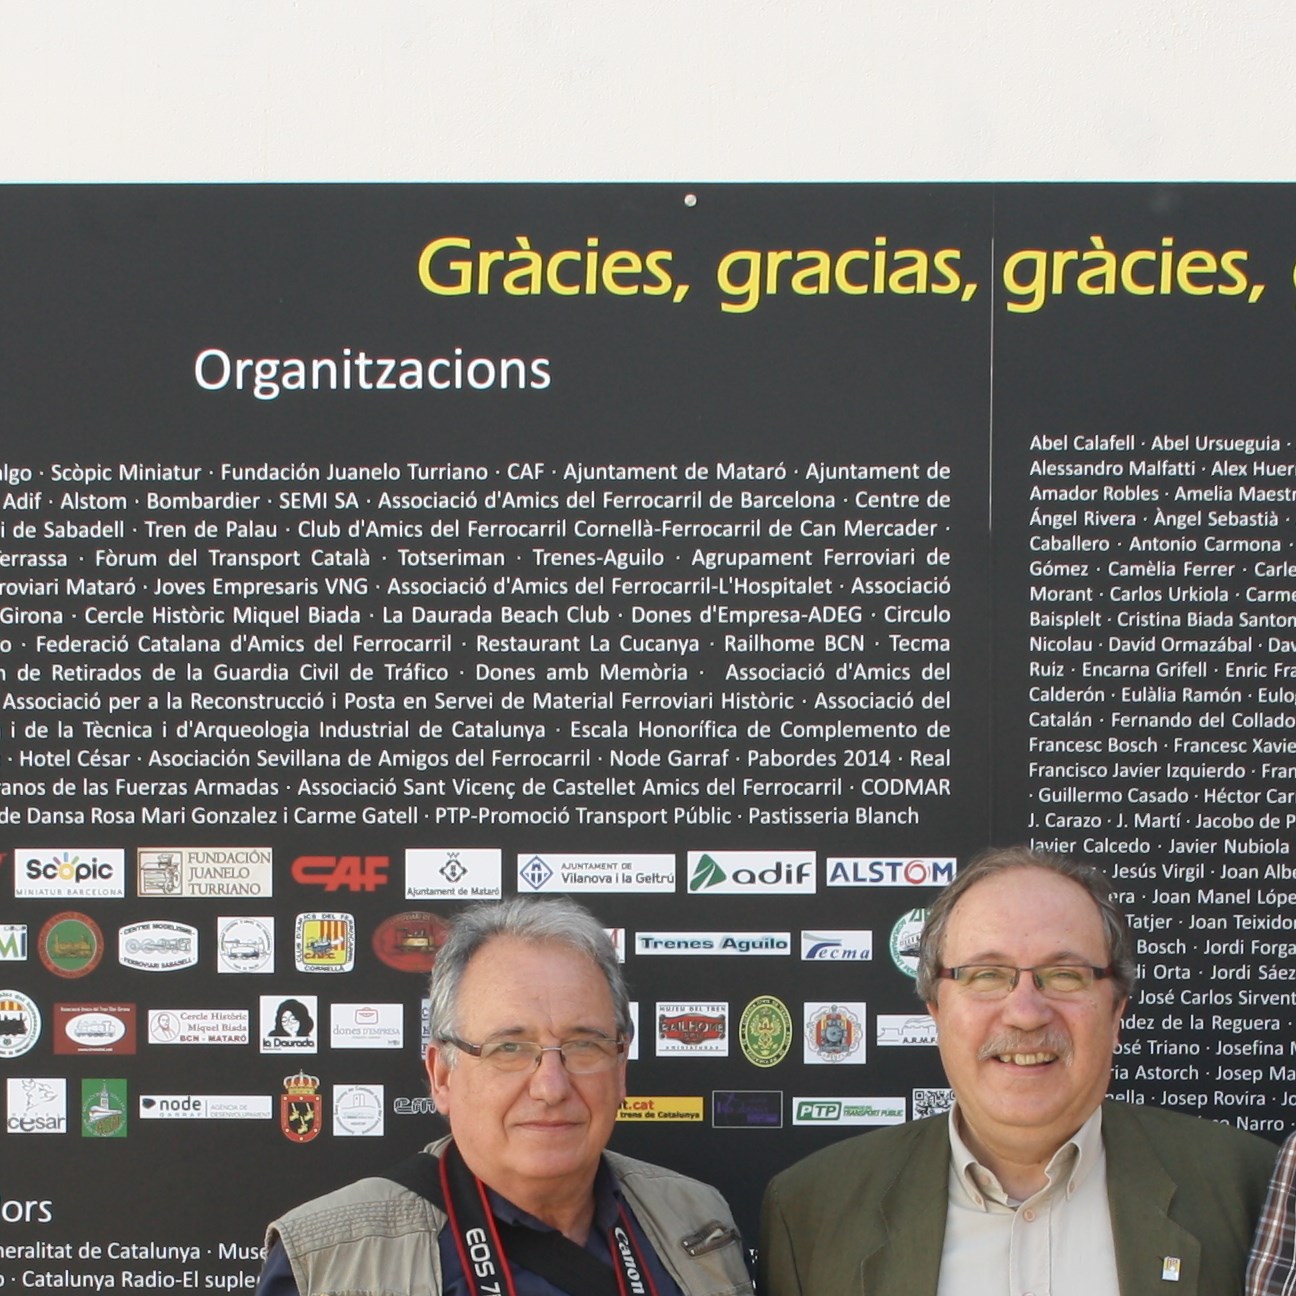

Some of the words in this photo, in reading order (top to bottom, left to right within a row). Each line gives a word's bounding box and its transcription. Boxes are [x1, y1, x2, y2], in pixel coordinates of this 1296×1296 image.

[418, 236, 690, 303] Gràcies,
[717, 236, 978, 313] gracias,
[1003, 235, 1265, 313] gràcies,
[194, 347, 551, 401] Organitzacions
[1029, 434, 1068, 451] Abel
[1073, 434, 1135, 451] Calafell
[1150, 434, 1189, 452] Abel
[1195, 435, 1281, 455] Ursueguia
[51, 462, 113, 485] Scòpic
[119, 462, 202, 481] Miniatur
[221, 462, 320, 481] Fundación
[326, 462, 401, 481] Juanelo
[406, 462, 488, 481] Turriano
[507, 462, 545, 481] CAF
[563, 462, 678, 484] Ajuntament
[684, 461, 709, 480] de
[716, 461, 787, 480] Mataró
[805, 462, 920, 484] Ajuntament
[926, 460, 951, 480] de
[27, 807, 85, 825] Dansa
[91, 807, 135, 825] Rosa
[141, 806, 186, 824] Mari
[191, 806, 278, 825] Gonzalez
[293, 806, 357, 825] Carme
[362, 806, 418, 825] Gatell
[435, 805, 570, 825] PTP-Promoció
[575, 806, 668, 829] Transport
[674, 806, 732, 825] Públic
[749, 806, 849, 825] Pastisseria
[855, 806, 919, 825] Blanch
[187, 851, 271, 865] FUNDACIÓN
[561, 862, 620, 870] AJUNTAMENT
[622, 862, 633, 870] DE
[188, 866, 250, 881] JUANELO
[291, 856, 390, 892] CAF
[561, 872, 612, 884] Vilanova
[621, 872, 632, 884] la
[635, 872, 675, 884] Geltrú
[732, 861, 813, 885] adif
[829, 860, 954, 885] ALSTOM
[1111, 862, 1157, 879] Jesús
[1161, 862, 1205, 883] Virgil
[1219, 864, 1259, 880] Joan
[16, 888, 63, 896] MINIATUR
[67, 888, 123, 896] BARCELONA
[188, 883, 261, 896] TURRIANO
[406, 887, 456, 898] Ajuntament
[458, 887, 468, 896] de
[471, 887, 500, 896] Mataró
[640, 937, 714, 950] Trenes
[721, 937, 789, 952] Aguilo
[180, 1012, 208, 1021] Cercle
[180, 1034, 200, 1043] BCN
[208, 1034, 248, 1043] MATARÓ
[274, 1037, 315, 1048] Daurada
[159, 1096, 202, 1112] node
[800, 1105, 838, 1118] PTP
[645, 1111, 654, 1119] de
[657, 1111, 700, 1120] Catalunya
[78, 1241, 102, 1260] de
[107, 1241, 201, 1264] Catalunya
[218, 1242, 268, 1260] Muse
[466, 1227, 496, 1279] EOS
[614, 1226, 645, 1294] Canon
[22, 1269, 115, 1292] Catalunya
[121, 1270, 199, 1288] Radio-El
[205, 1270, 261, 1292] suple
